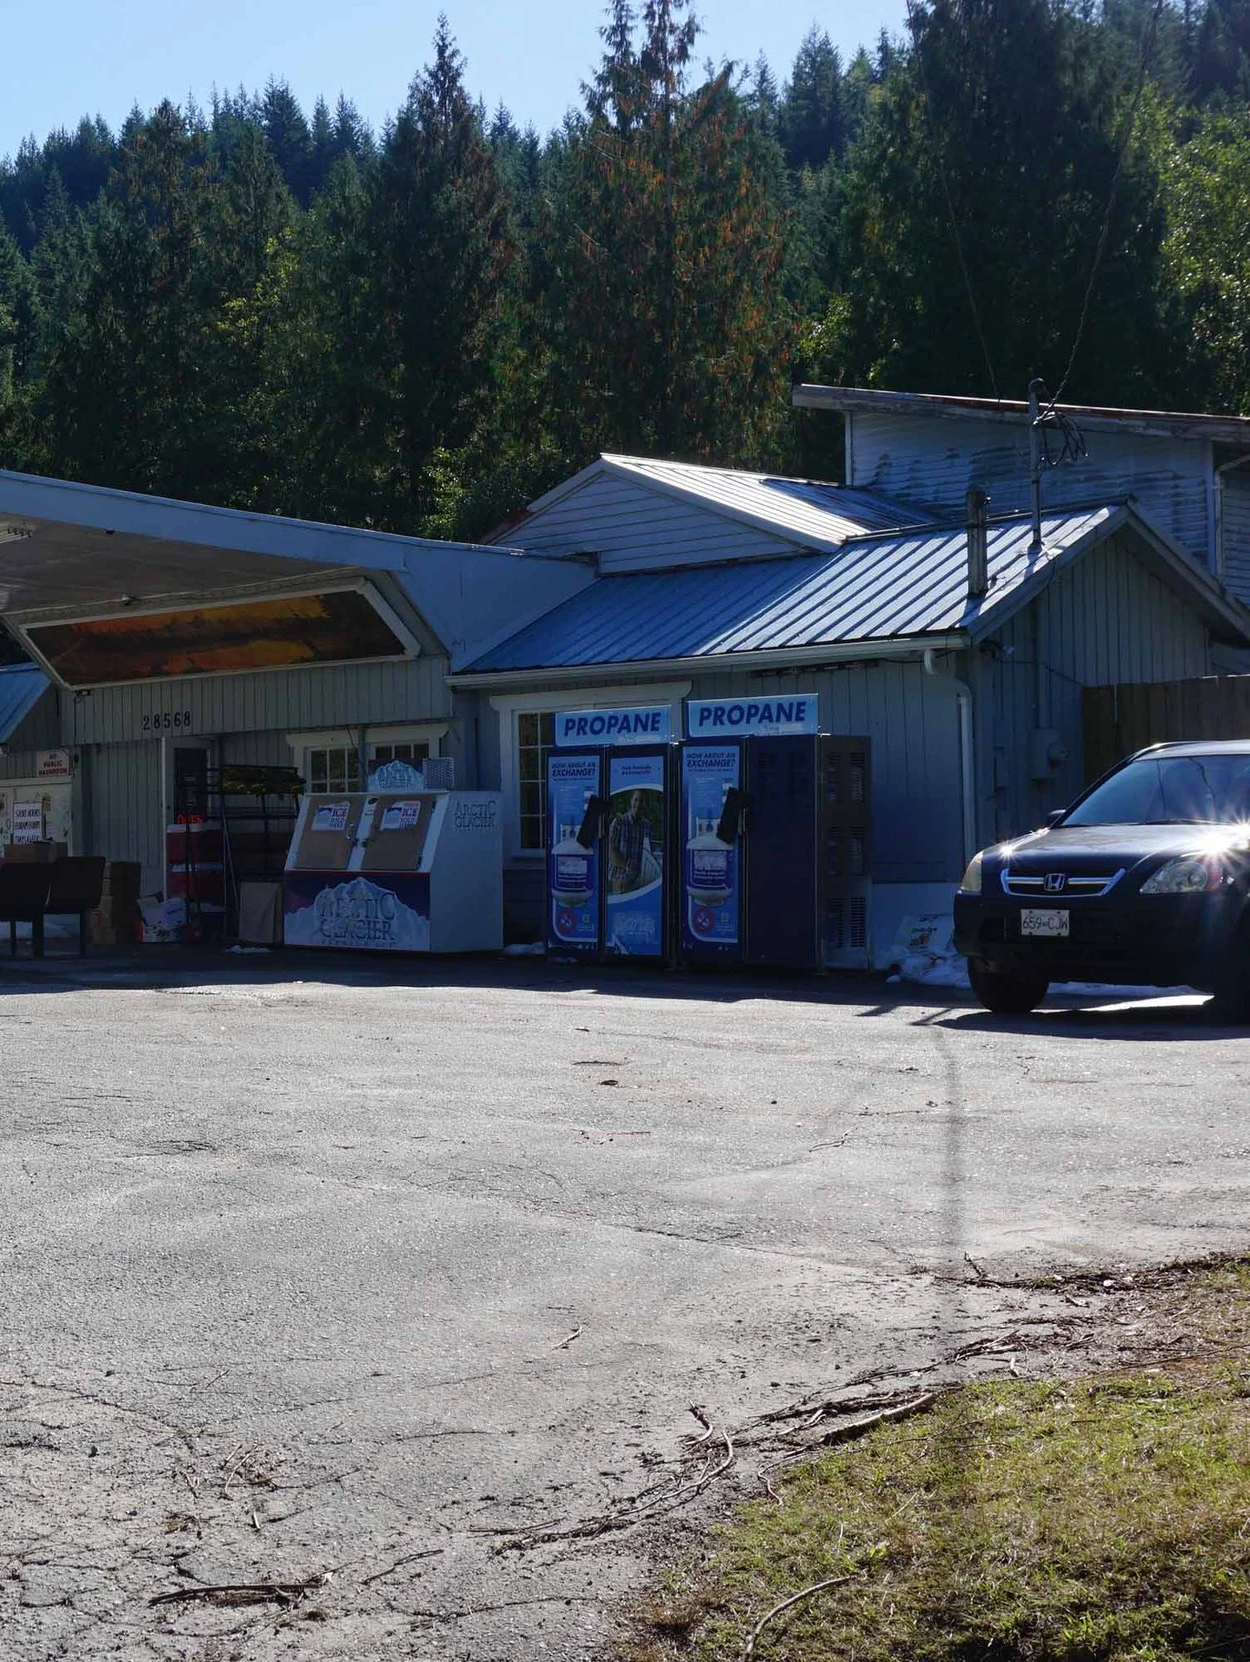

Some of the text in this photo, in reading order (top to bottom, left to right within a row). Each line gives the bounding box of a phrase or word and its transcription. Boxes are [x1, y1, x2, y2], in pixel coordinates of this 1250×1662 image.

[143, 711, 191, 730] 28568
[698, 701, 807, 726] PROPANE
[564, 712, 662, 736] PROPANE
[332, 808, 347, 817] ICE
[402, 808, 417, 817] ICE
[454, 800, 496, 816] ARCTIC
[454, 816, 495, 828] GLACIER
